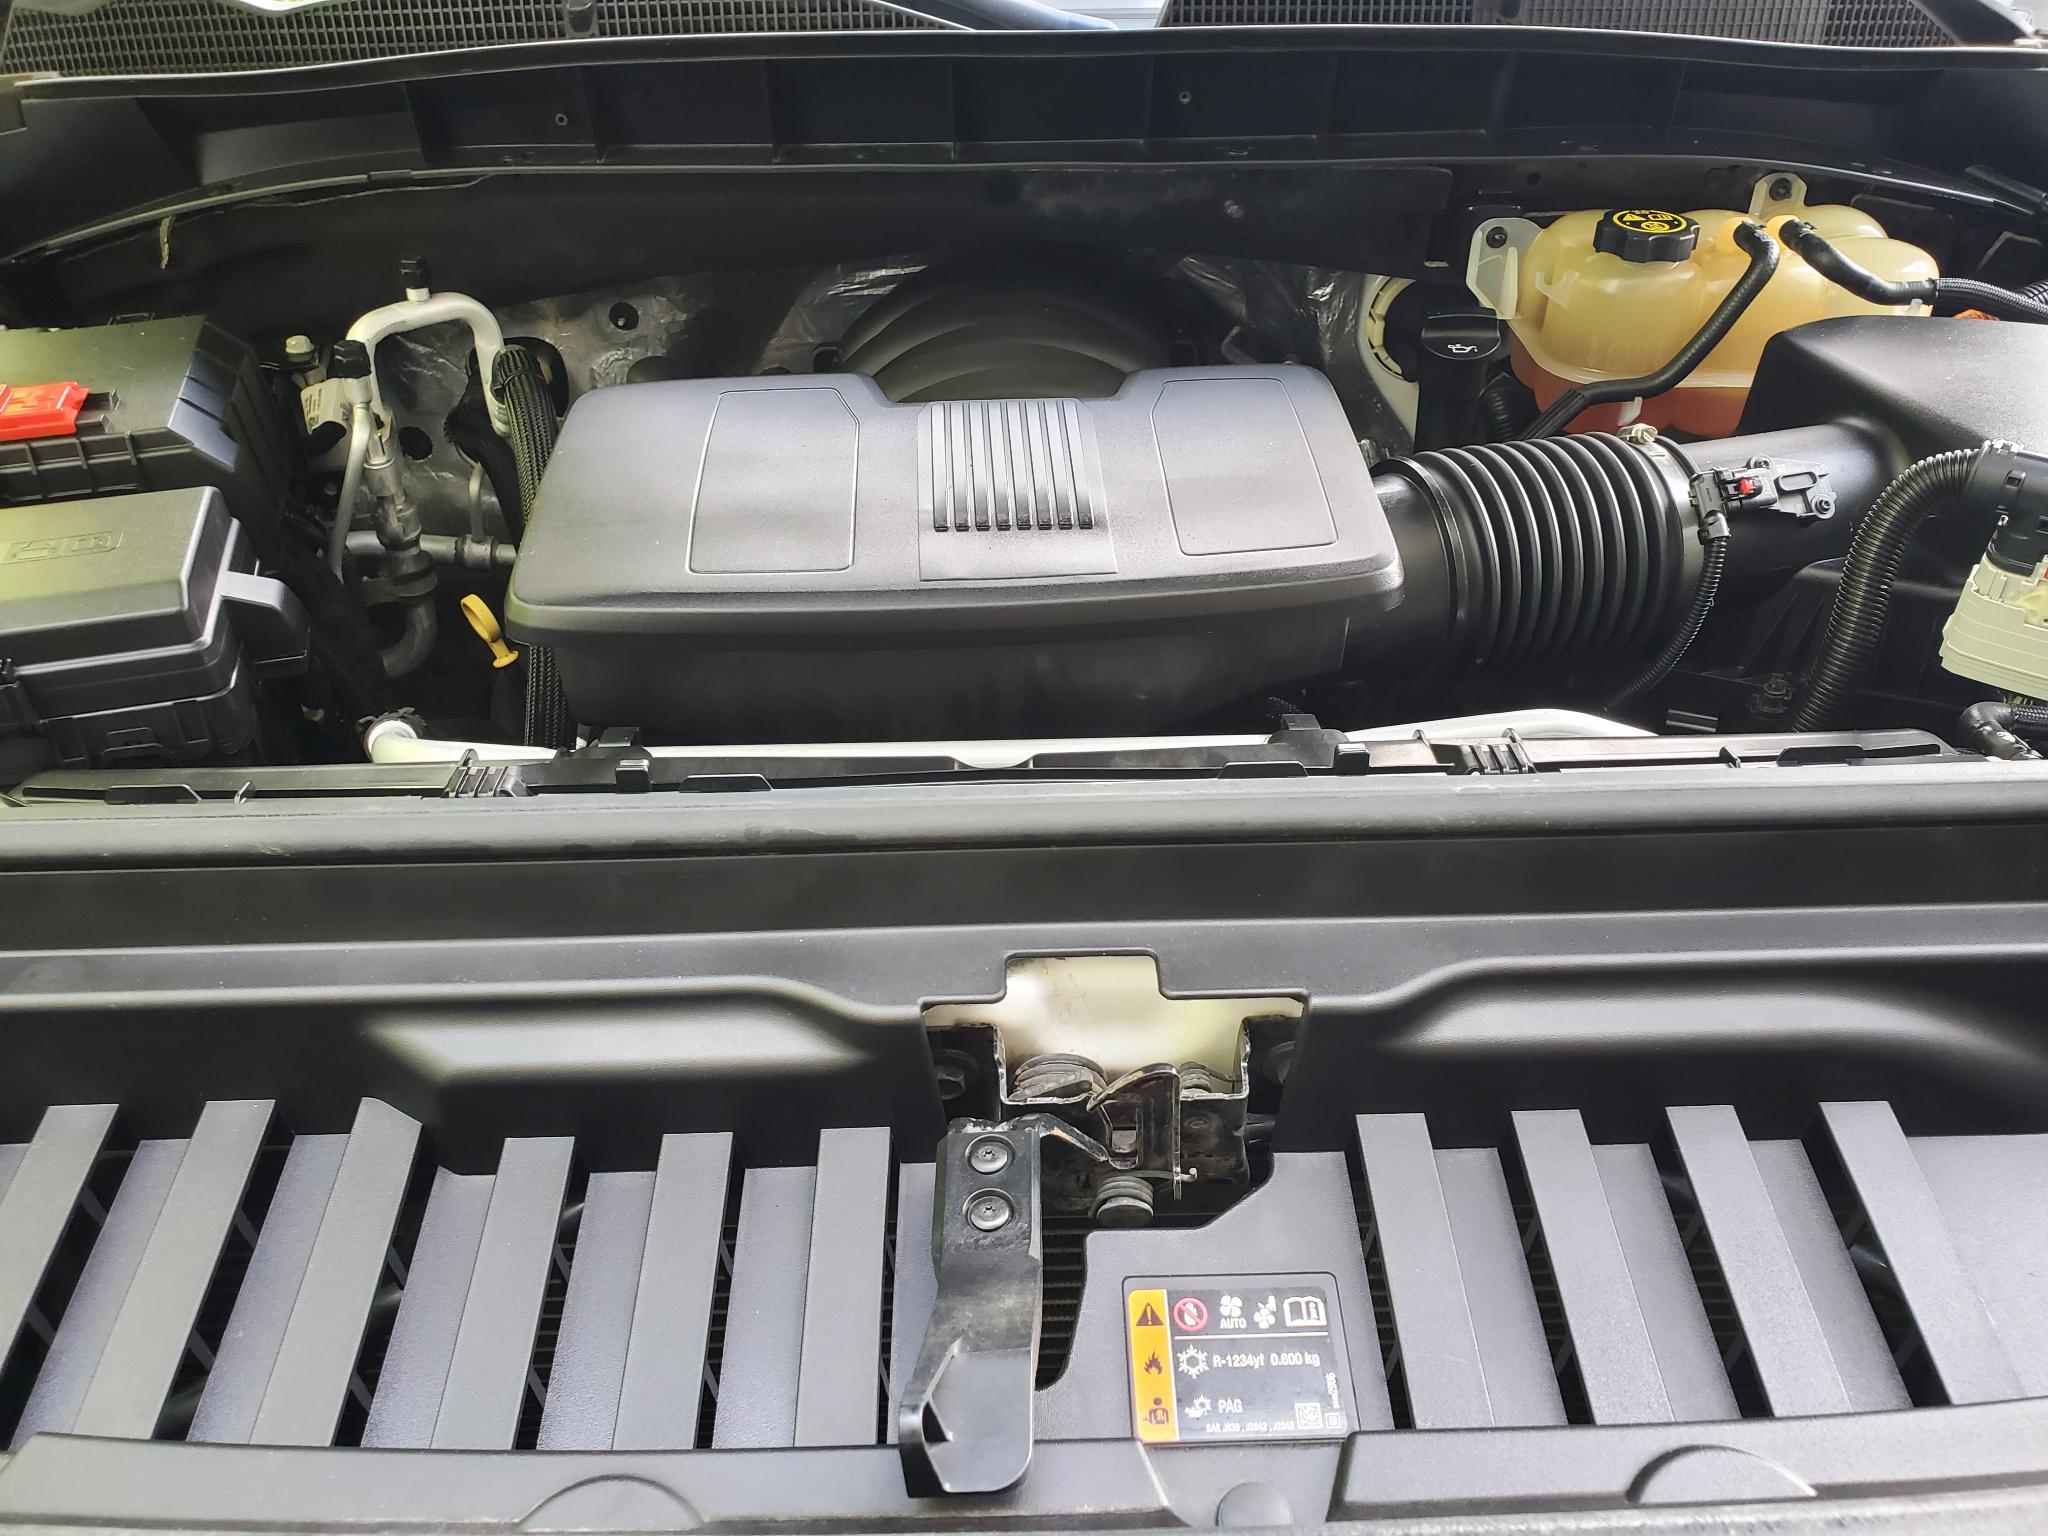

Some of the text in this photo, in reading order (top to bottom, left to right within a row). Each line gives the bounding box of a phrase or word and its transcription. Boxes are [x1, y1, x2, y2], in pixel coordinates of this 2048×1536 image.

[1220, 1317, 1247, 1329] AUTO
[1212, 1351, 1321, 1369] R-1234yf 0.600 kg
[1218, 1399, 1243, 1413] PAG
